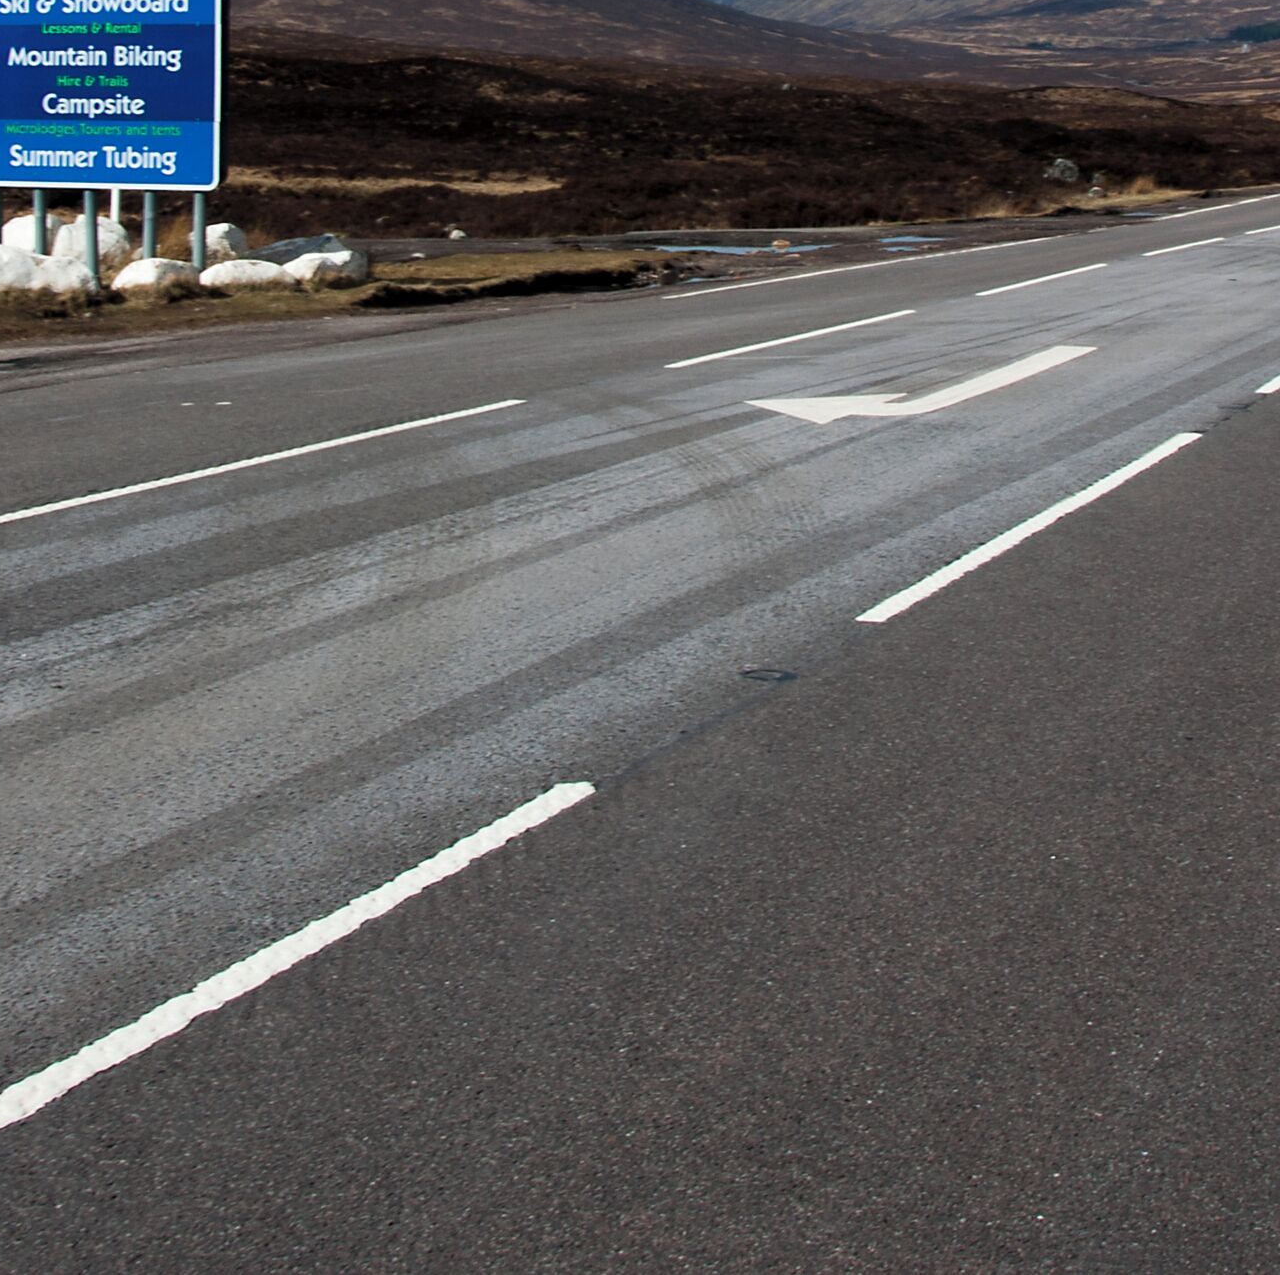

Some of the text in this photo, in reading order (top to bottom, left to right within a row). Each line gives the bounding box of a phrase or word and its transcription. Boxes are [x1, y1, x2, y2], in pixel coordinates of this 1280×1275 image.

[42, 22, 142, 35] Lessons & Rental
[8, 45, 182, 71] Mountain Biking
[57, 75, 129, 87] Hire & Trails
[42, 93, 145, 118] Campsite
[126, 123, 148, 136] and
[10, 145, 177, 175] Summer Tubing
